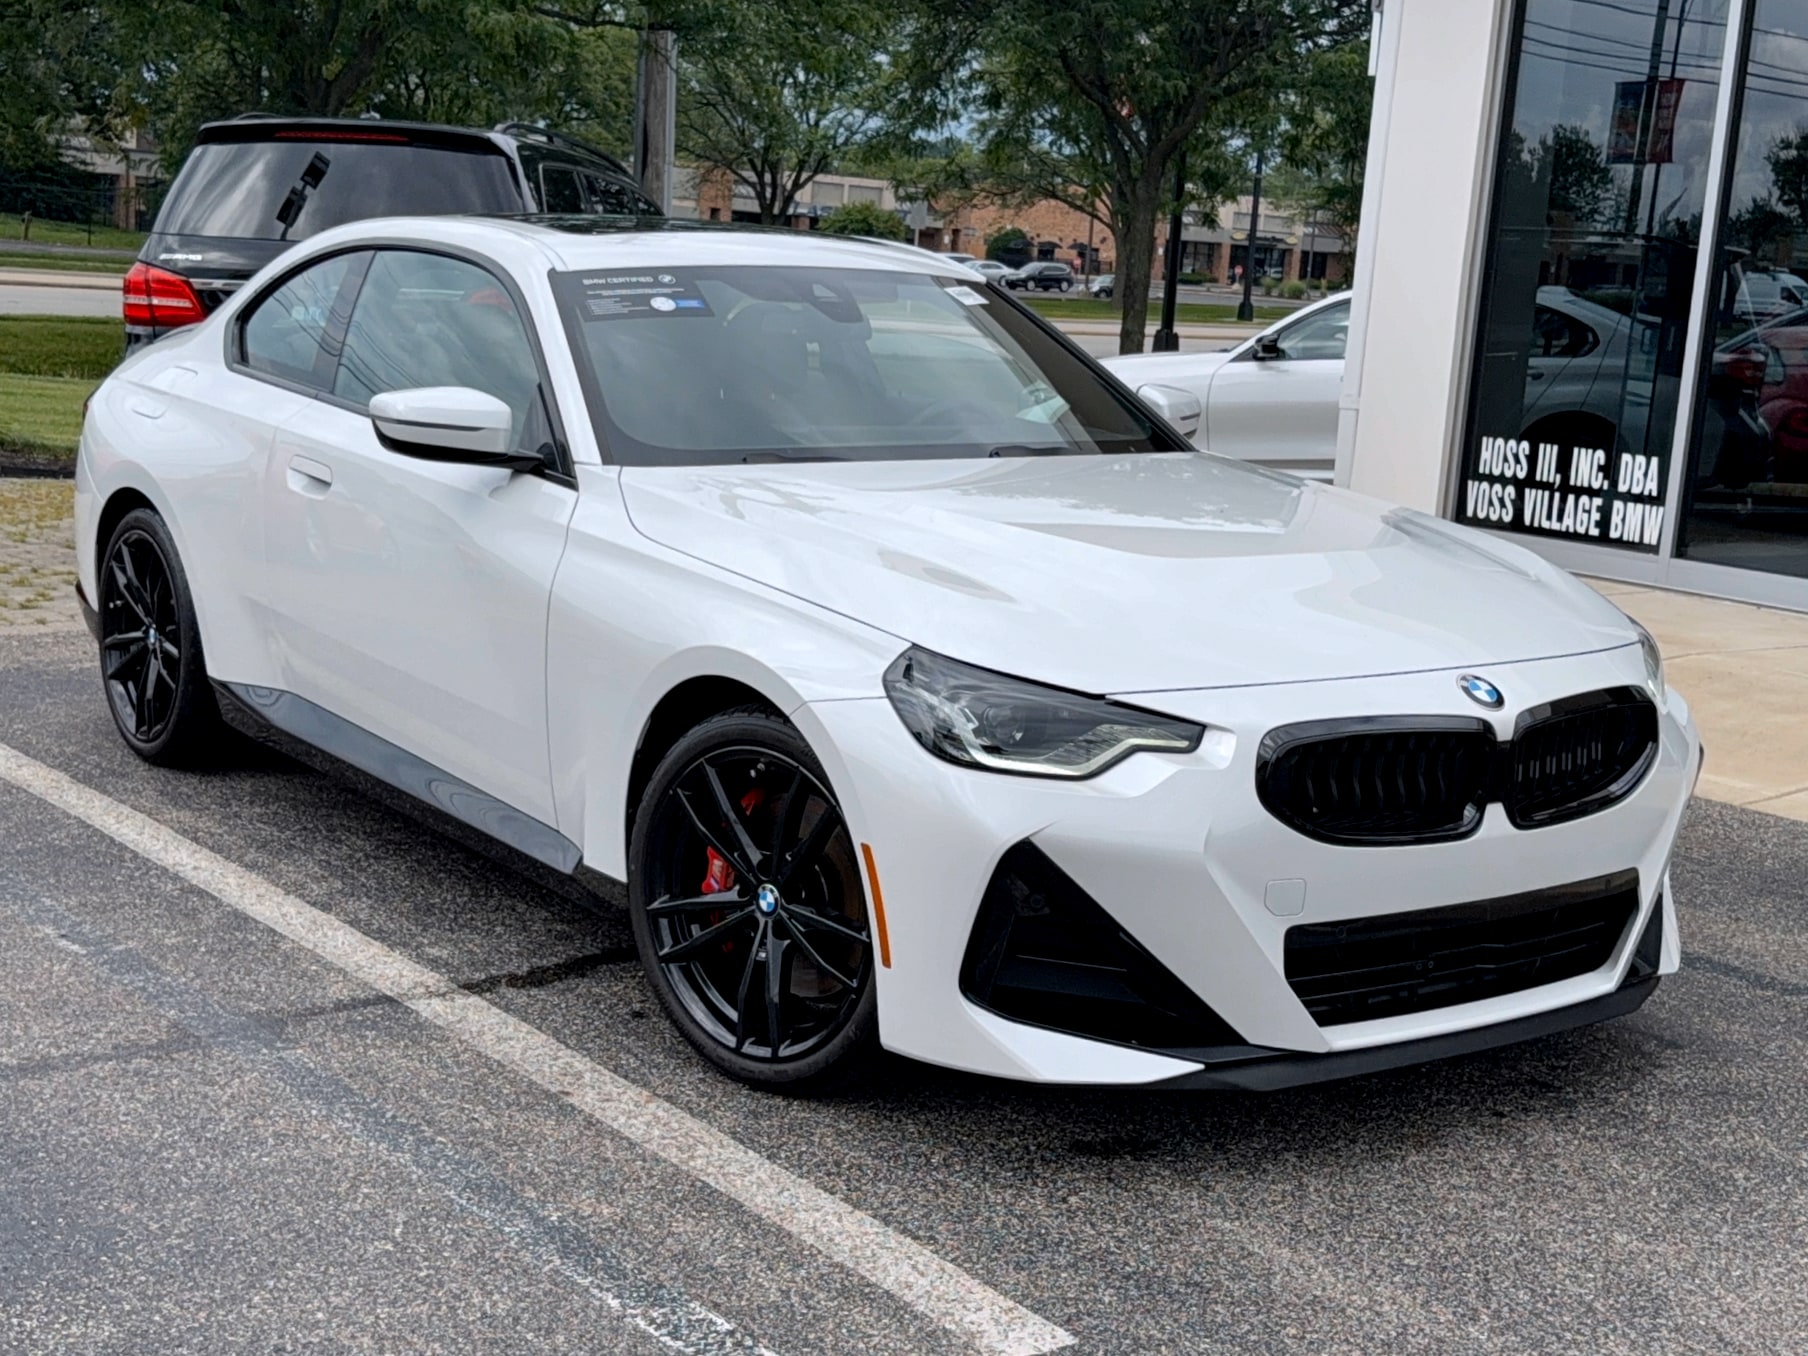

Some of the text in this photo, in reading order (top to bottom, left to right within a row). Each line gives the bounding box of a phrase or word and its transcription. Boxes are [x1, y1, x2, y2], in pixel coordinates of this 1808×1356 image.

[582, 276, 654, 286] BMW CERTIFIED
[1479, 436, 1659, 497] HOSS III, INC. DBA
[1466, 480, 1665, 546] VOSS VILLAGE BMW
